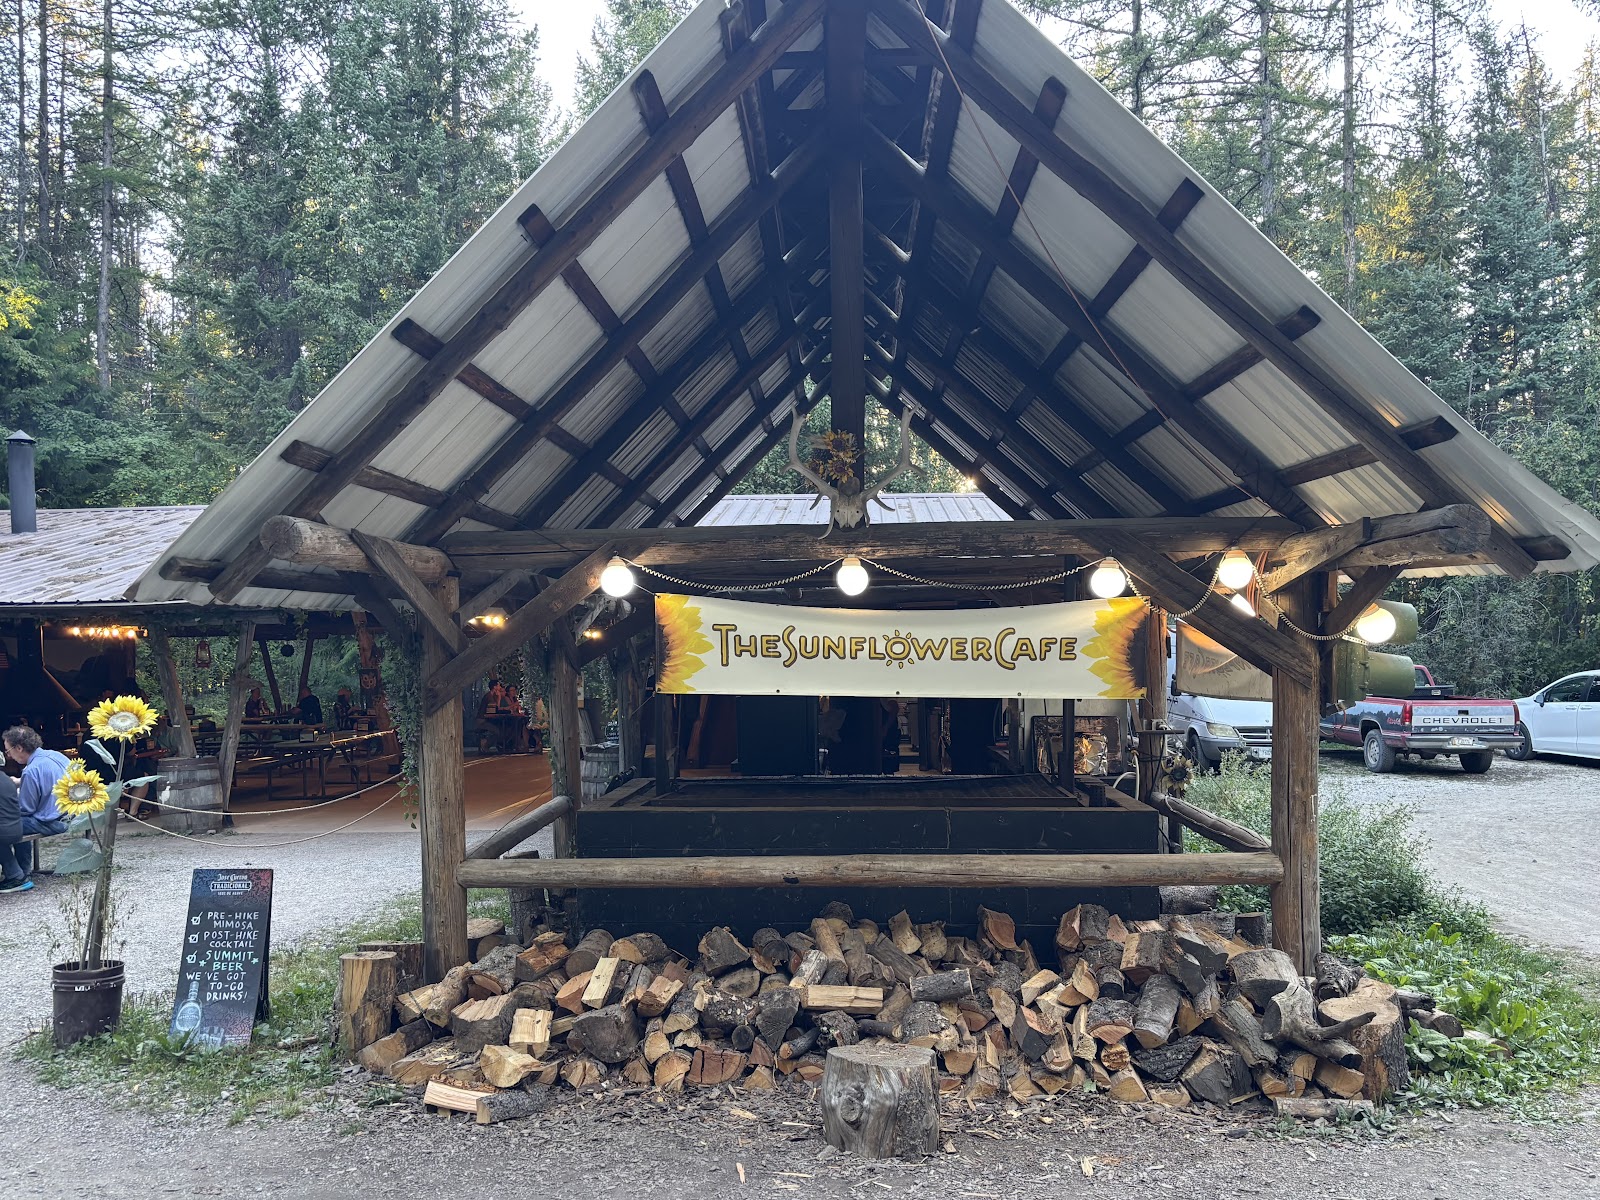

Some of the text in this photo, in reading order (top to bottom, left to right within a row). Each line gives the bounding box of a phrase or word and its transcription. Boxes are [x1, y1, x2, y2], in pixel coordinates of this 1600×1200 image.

[213, 920, 254, 930] MIMOSA
[203, 930, 259, 941] POST-HIKE
[209, 940, 254, 949] COCKTAIL
[205, 950, 254, 962] SUMMIT
[212, 961, 244, 971] BEER
[226, 972, 247, 981] GOT
[209, 981, 244, 991] TO-GO
[206, 991, 248, 1004] DRINKS!
